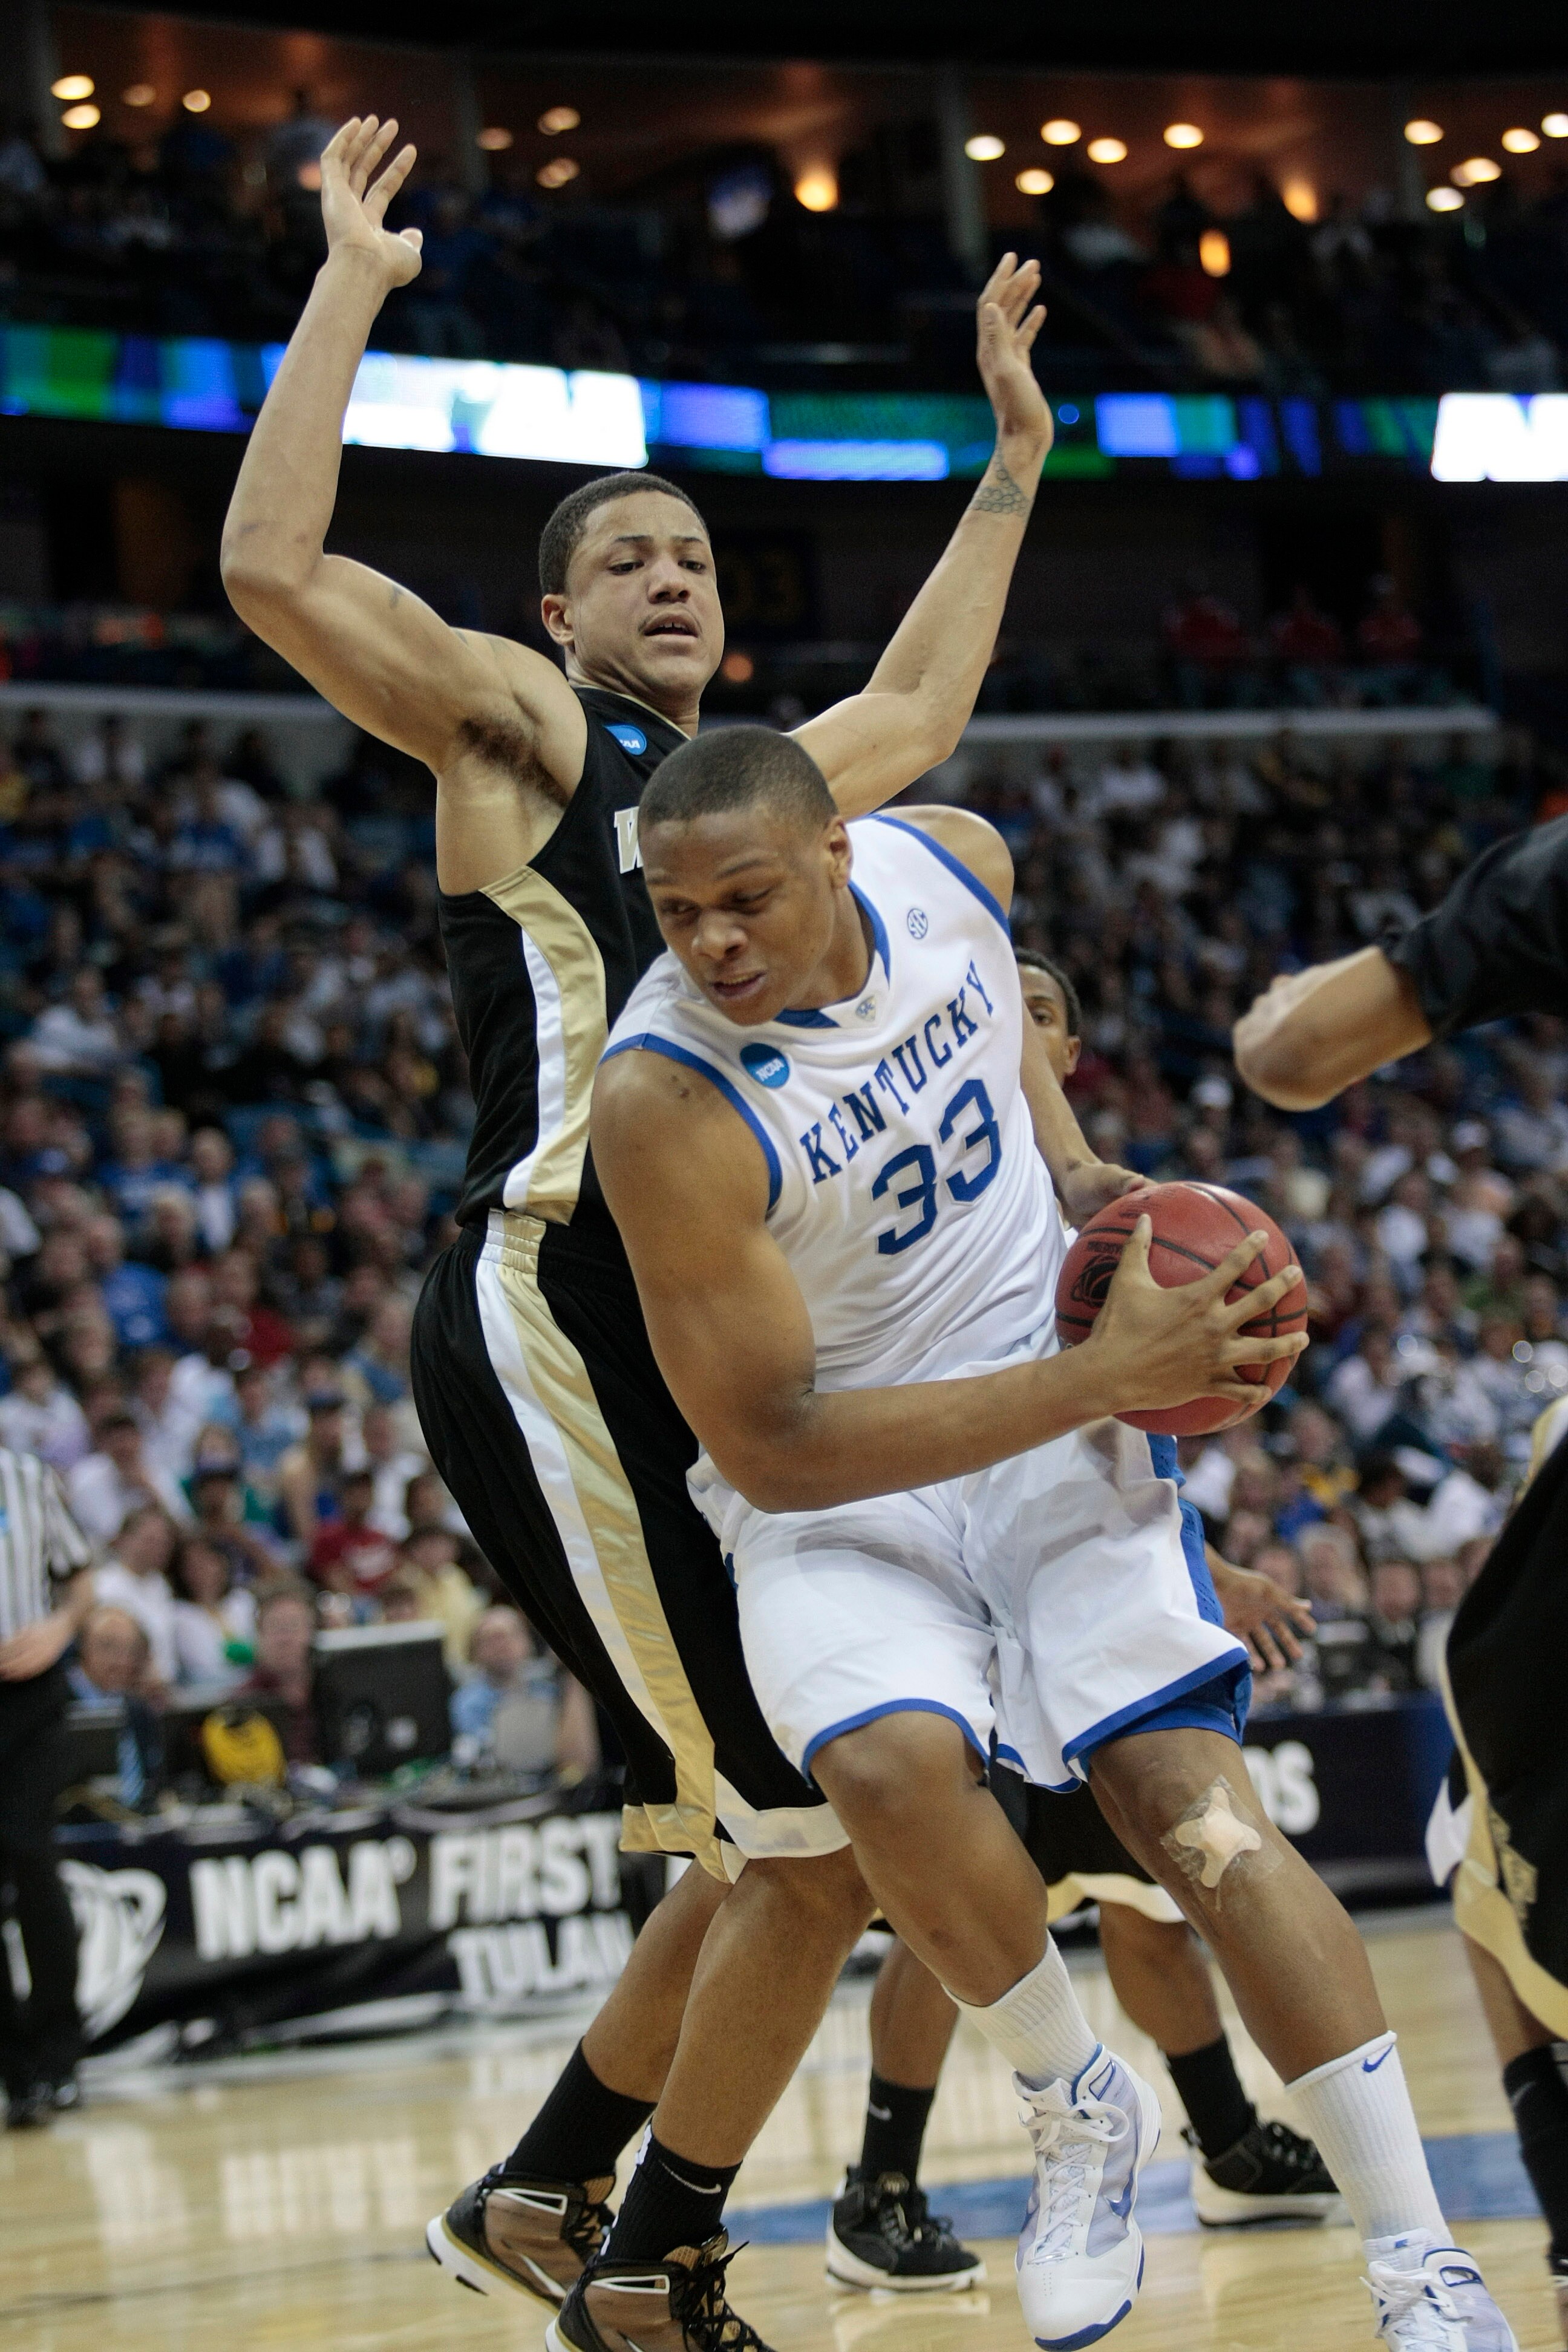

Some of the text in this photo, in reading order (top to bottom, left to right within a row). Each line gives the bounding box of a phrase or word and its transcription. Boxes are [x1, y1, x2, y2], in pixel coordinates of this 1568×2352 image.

[756, 1057, 785, 1082] NCAA
[800, 960, 994, 1184] KENTUCKY
[872, 1079, 1002, 1256] 33
[427, 1814, 623, 1930] FIRST
[446, 1909, 634, 2005] TULAN
